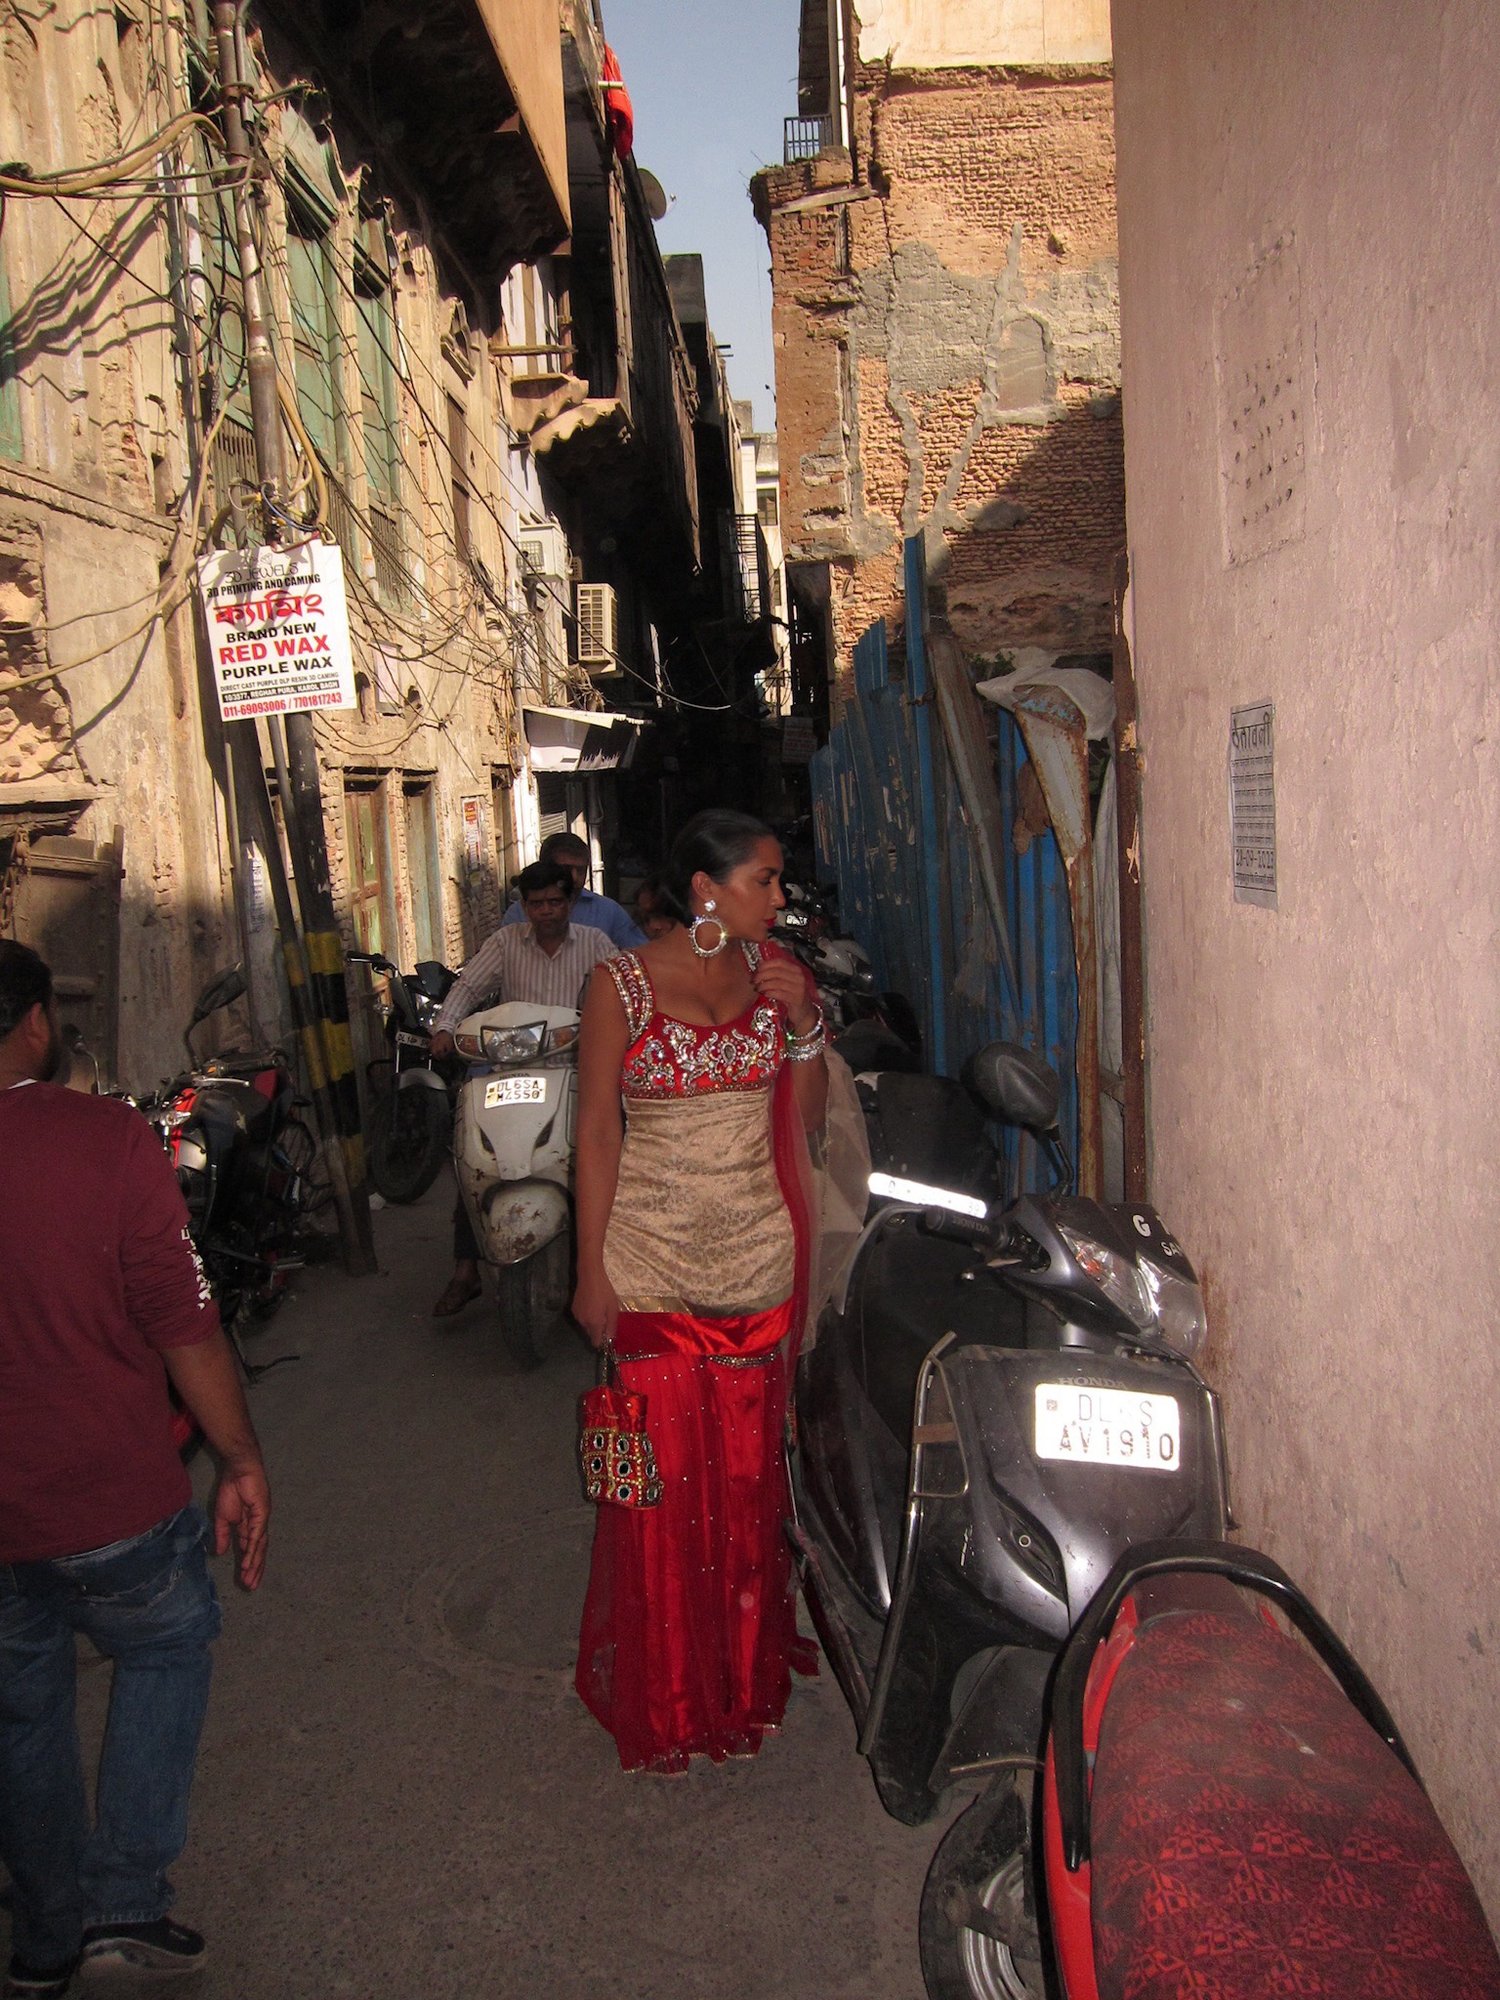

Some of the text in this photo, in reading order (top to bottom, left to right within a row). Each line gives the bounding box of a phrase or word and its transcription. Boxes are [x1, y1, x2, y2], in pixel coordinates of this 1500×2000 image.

[225, 562, 299, 584] 3D JEWELS
[206, 573, 321, 598] 3D PRINTING AND CAMING
[226, 622, 317, 644] BRAND NEW
[219, 634, 331, 666] RED WAX
[222, 656, 333, 681] PURPLE WAX
[220, 684, 240, 693] DIRECT
[241, 682, 256, 690] CAST
[257, 679, 279, 688] PURPLE
[280, 677, 290, 685] DLP
[291, 675, 308, 683] RESIN
[317, 672, 339, 680] CAMING
[298, 683, 320, 692] KAROL
[320, 680, 338, 689] BAGH
[223, 699, 287, 718] 011-69093006
[294, 691, 343, 709] 7701817243
[1057, 1376, 1128, 1391] HONDA
